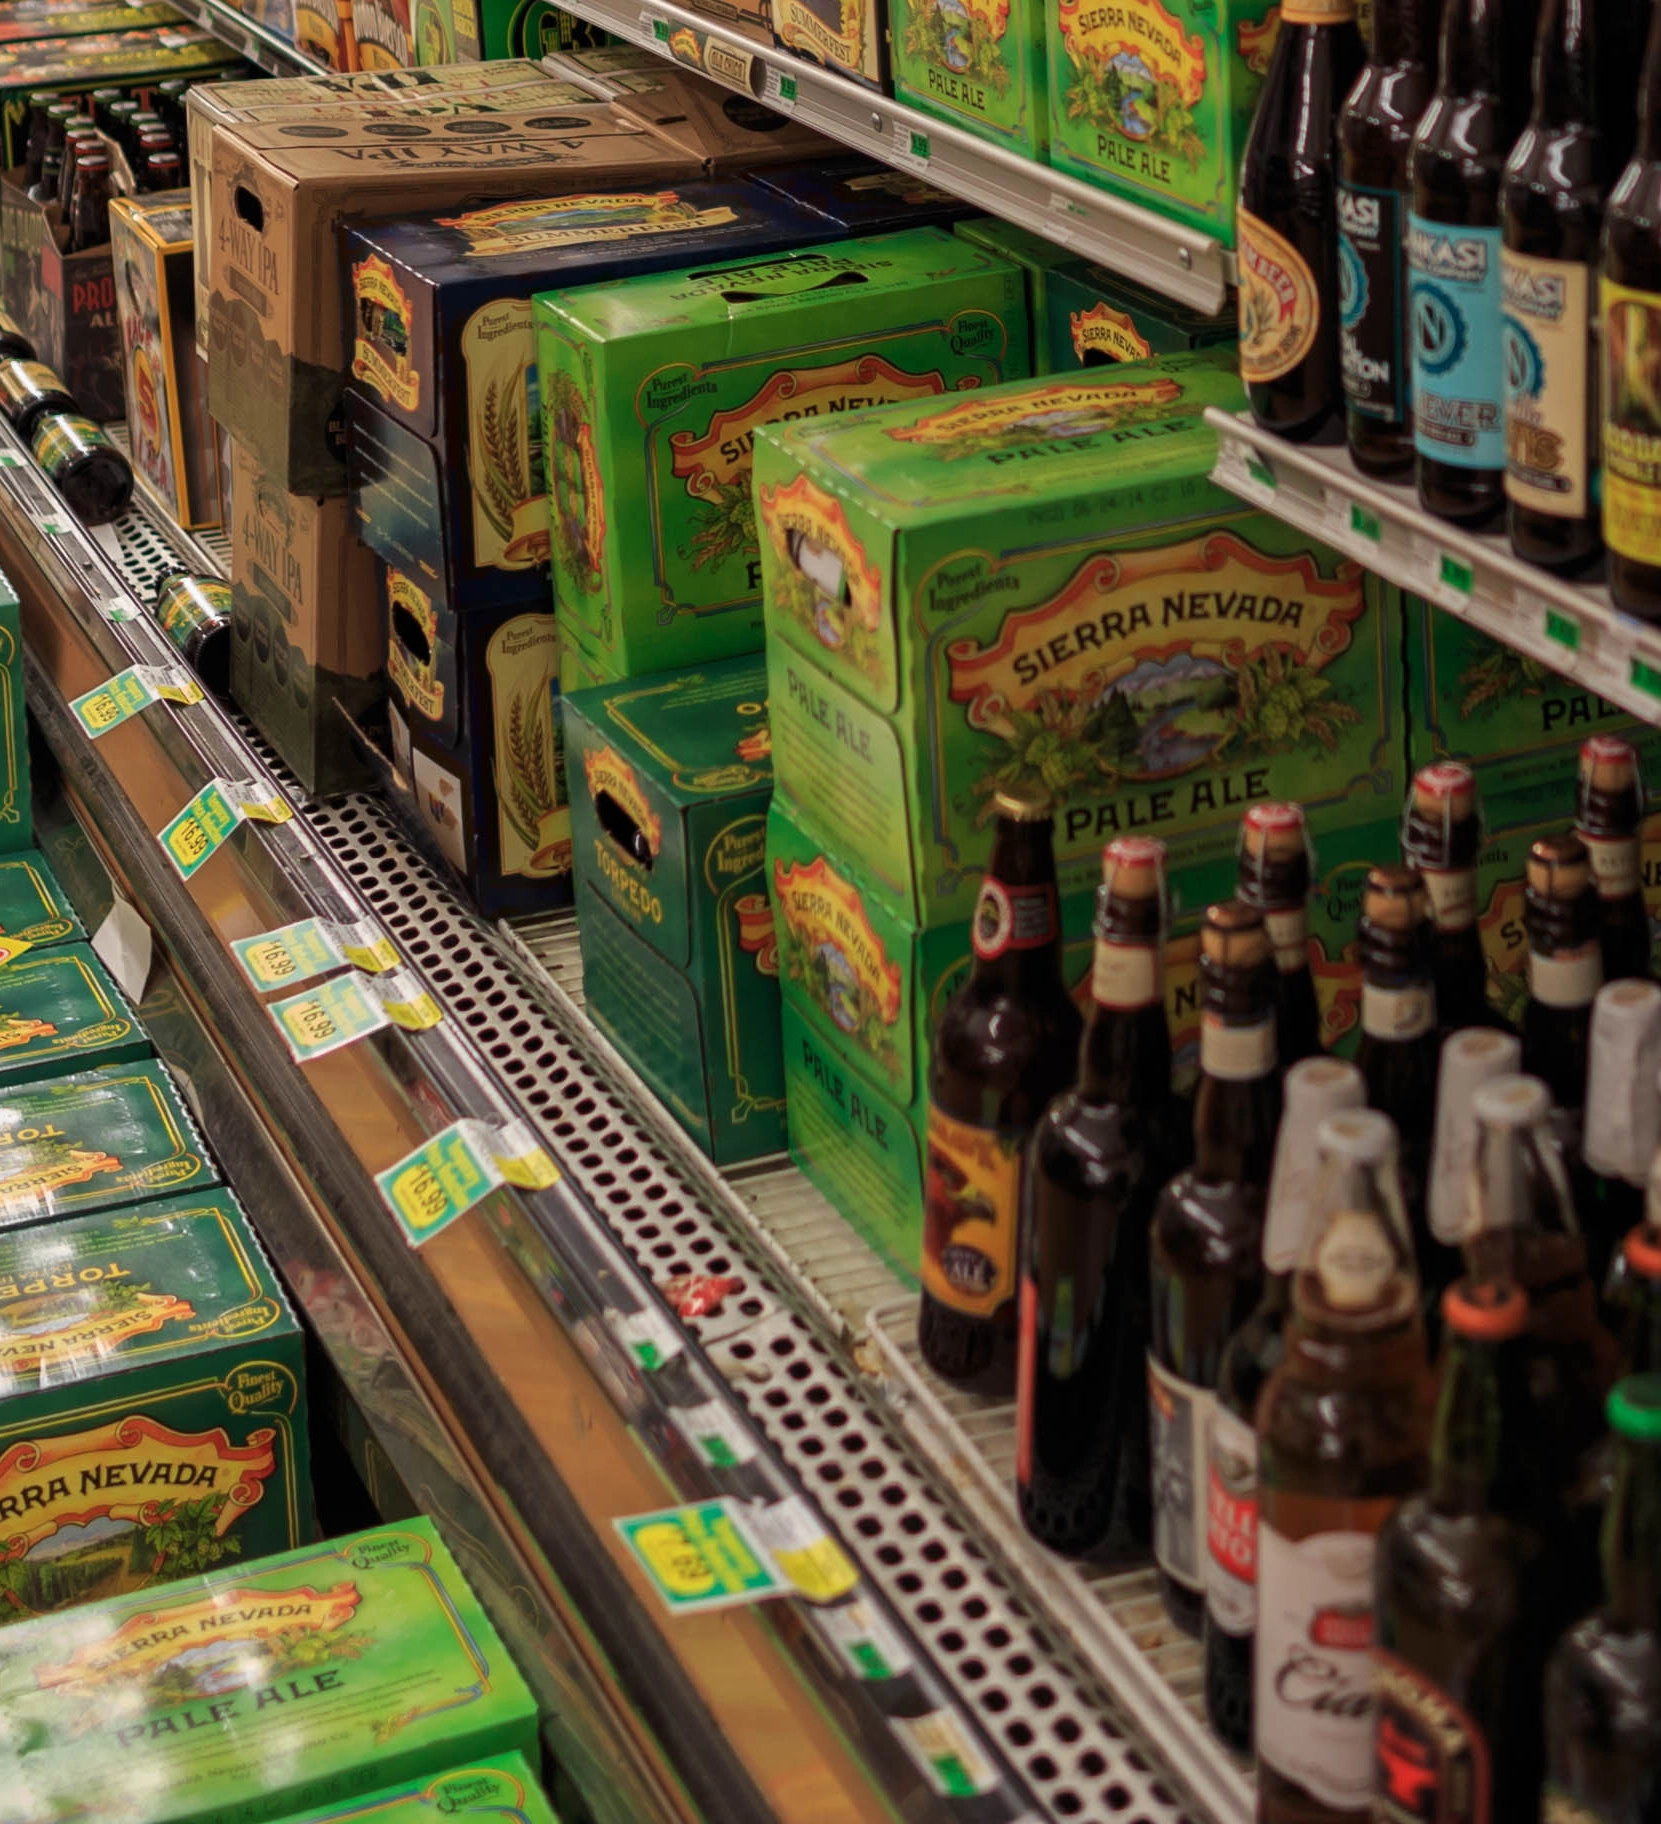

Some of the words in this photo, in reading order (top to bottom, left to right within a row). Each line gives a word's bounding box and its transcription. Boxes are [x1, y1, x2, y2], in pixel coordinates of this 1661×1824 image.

[791, 4, 852, 63] SUMMERFEST
[1078, 8, 1124, 35] SIERRA
[1126, 14, 1182, 64] NEVADA
[928, 68, 958, 99] PALE
[962, 84, 985, 111] ALE
[332, 145, 421, 162] IPA
[1097, 134, 1136, 173] PALE
[1141, 151, 1171, 184] ALE
[541, 195, 644, 211] NEVADA
[504, 218, 710, 245] SUMMERFEST
[218, 215, 255, 275] 4-WAY
[258, 242, 280, 296] IPA
[73, 277, 115, 314] PRO
[90, 311, 115, 329] AL
[1082, 327, 1111, 343] SIERRA
[1113, 331, 1141, 360] NEVA
[645, 380, 718, 410] Ingredients
[936, 402, 1030, 435] SIERRA
[1036, 387, 1140, 407] NEVADA
[987, 435, 1102, 467] PALE
[1110, 418, 1193, 445] ALE
[242, 513, 280, 583] 4-WAY
[282, 555, 303, 606] IPA
[1011, 602, 1150, 686] SIERRA
[1161, 590, 1305, 630] NEVADA
[92, 693, 121, 723] $16.99
[786, 667, 835, 732] PALE
[835, 713, 874, 763] ALE
[1541, 692, 1630, 732] PAL
[1064, 790, 1175, 843] PALE
[1189, 766, 1271, 817] ALE
[177, 816, 208, 857] $16.99
[715, 840, 766, 875] Ingred
[790, 886, 834, 923] SIERRA
[835, 906, 882, 985] NEVADA
[266, 939, 298, 977] $16.99
[306, 999, 337, 1040] $16.99
[801, 1037, 846, 1108] PALE
[849, 1095, 890, 1149] ALE
[2, 1163, 83, 1195] SIERRA
[407, 1158, 449, 1216] $16.99
[63, 1309, 154, 1346] SIERRA
[226, 1379, 285, 1413] Quality
[236, 1371, 277, 1393] Finest
[78, 1461, 218, 1500] NEVADA
[348, 1540, 413, 1571] Quality
[200, 1598, 313, 1632] NEVADA
[117, 1700, 240, 1751] PALE
[254, 1667, 348, 1712] ALE
